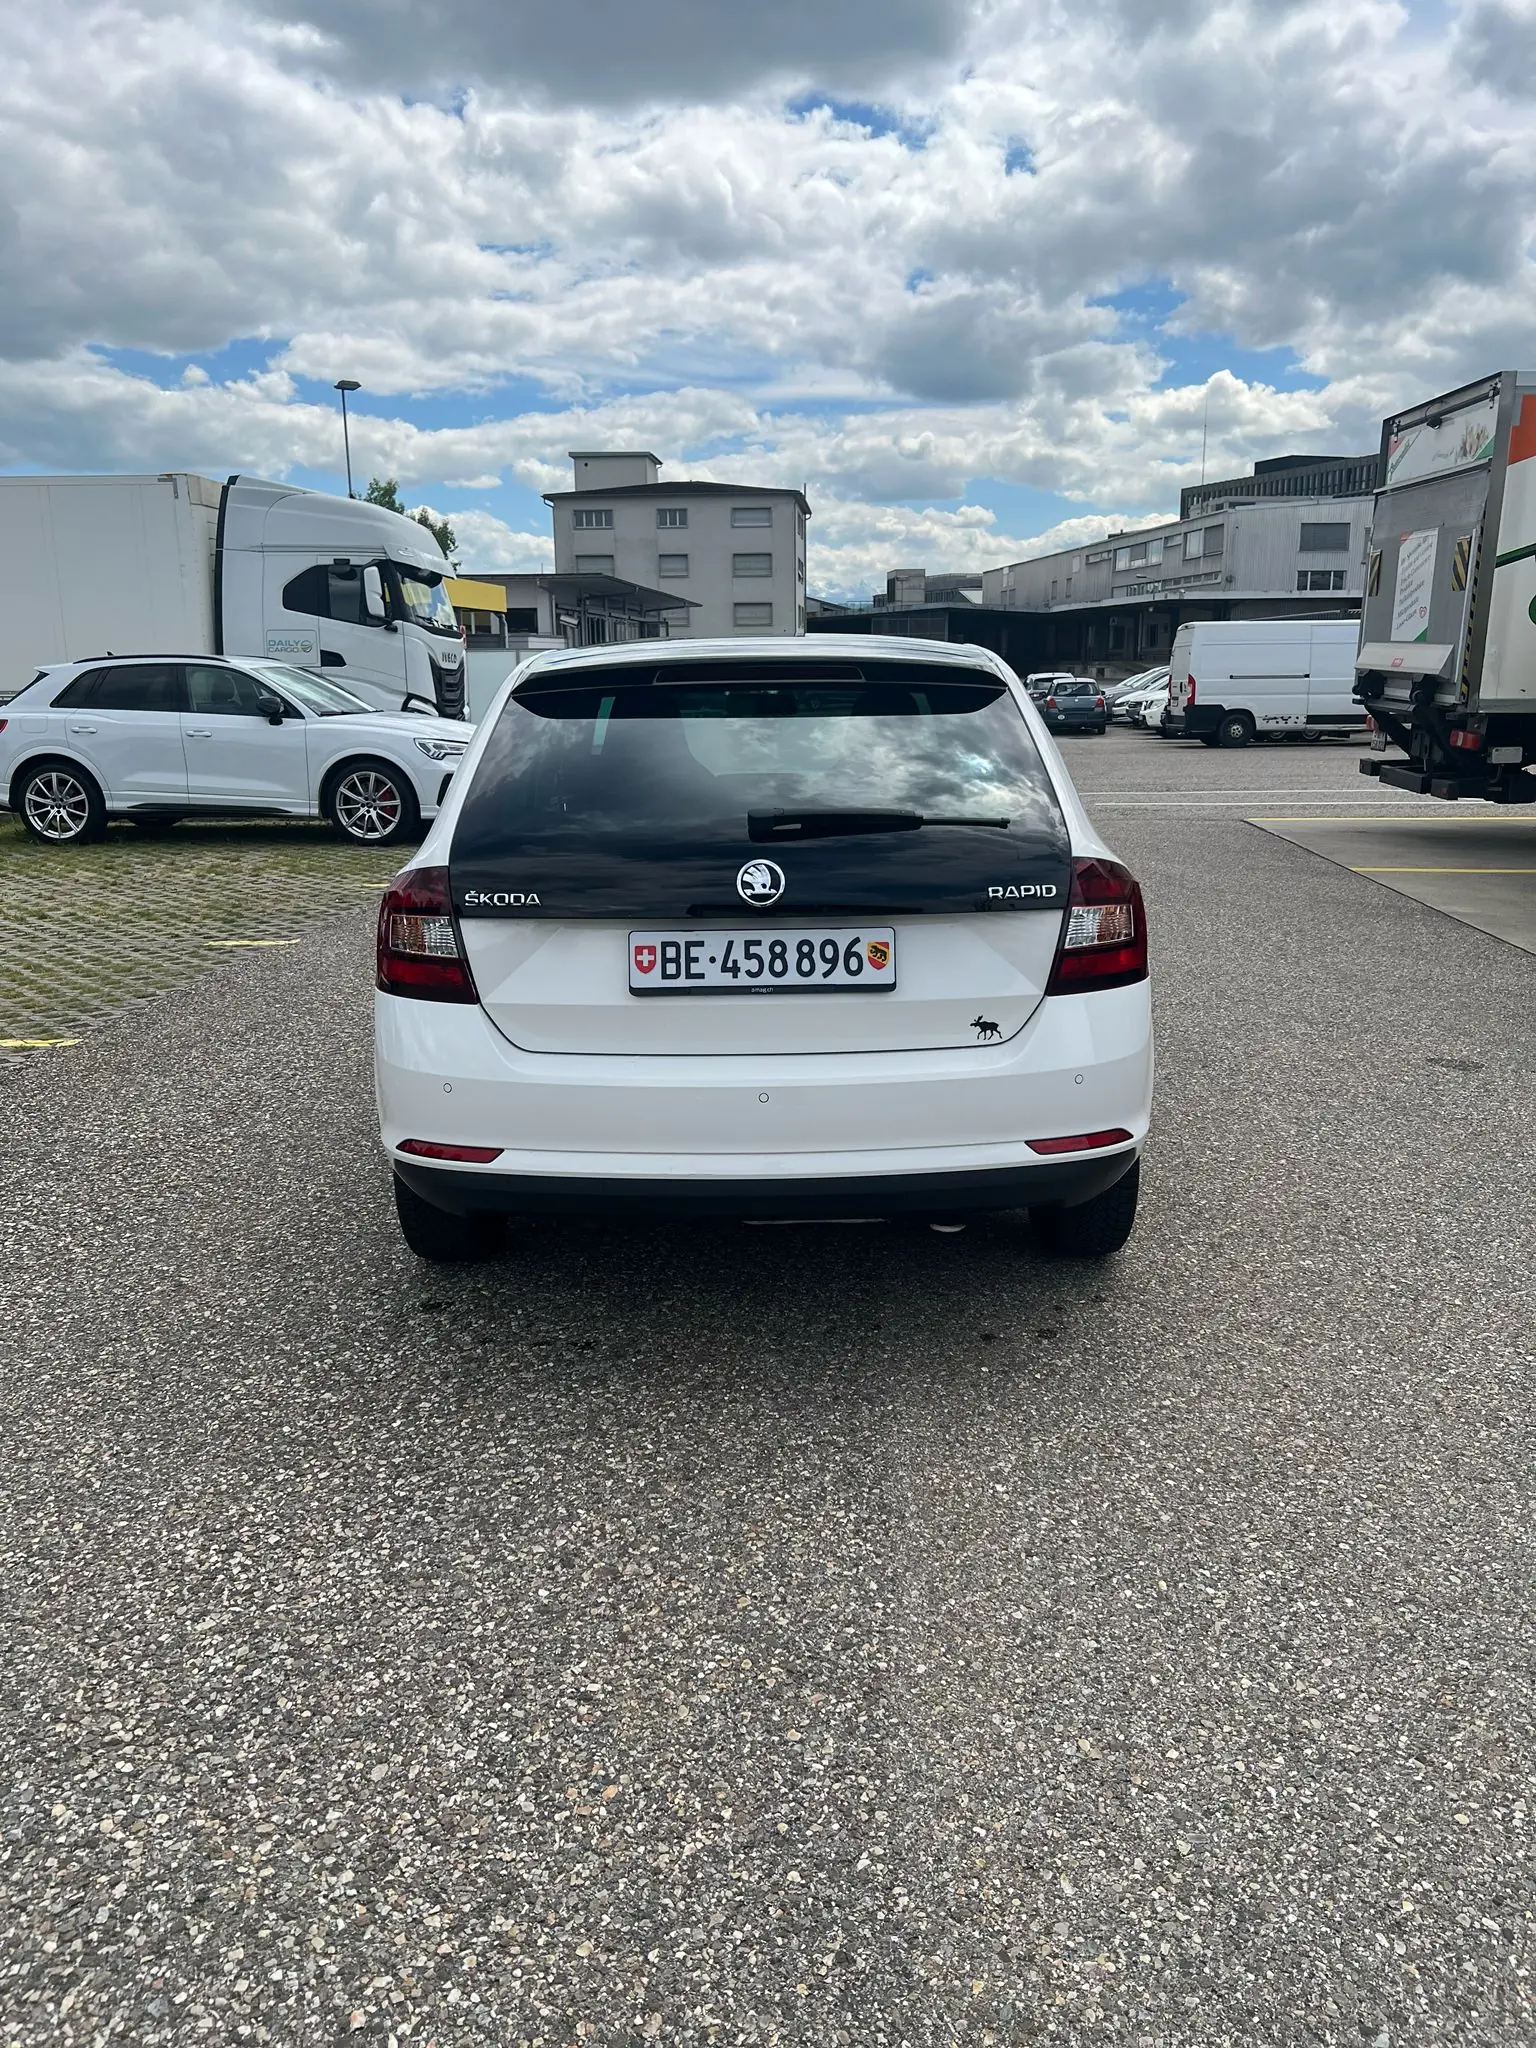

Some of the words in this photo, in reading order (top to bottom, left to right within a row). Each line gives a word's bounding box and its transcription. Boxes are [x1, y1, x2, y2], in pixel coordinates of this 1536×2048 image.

[441, 651, 457, 664] IVECO
[464, 890, 542, 906] ŠKODA
[987, 884, 1057, 900] RAPID
